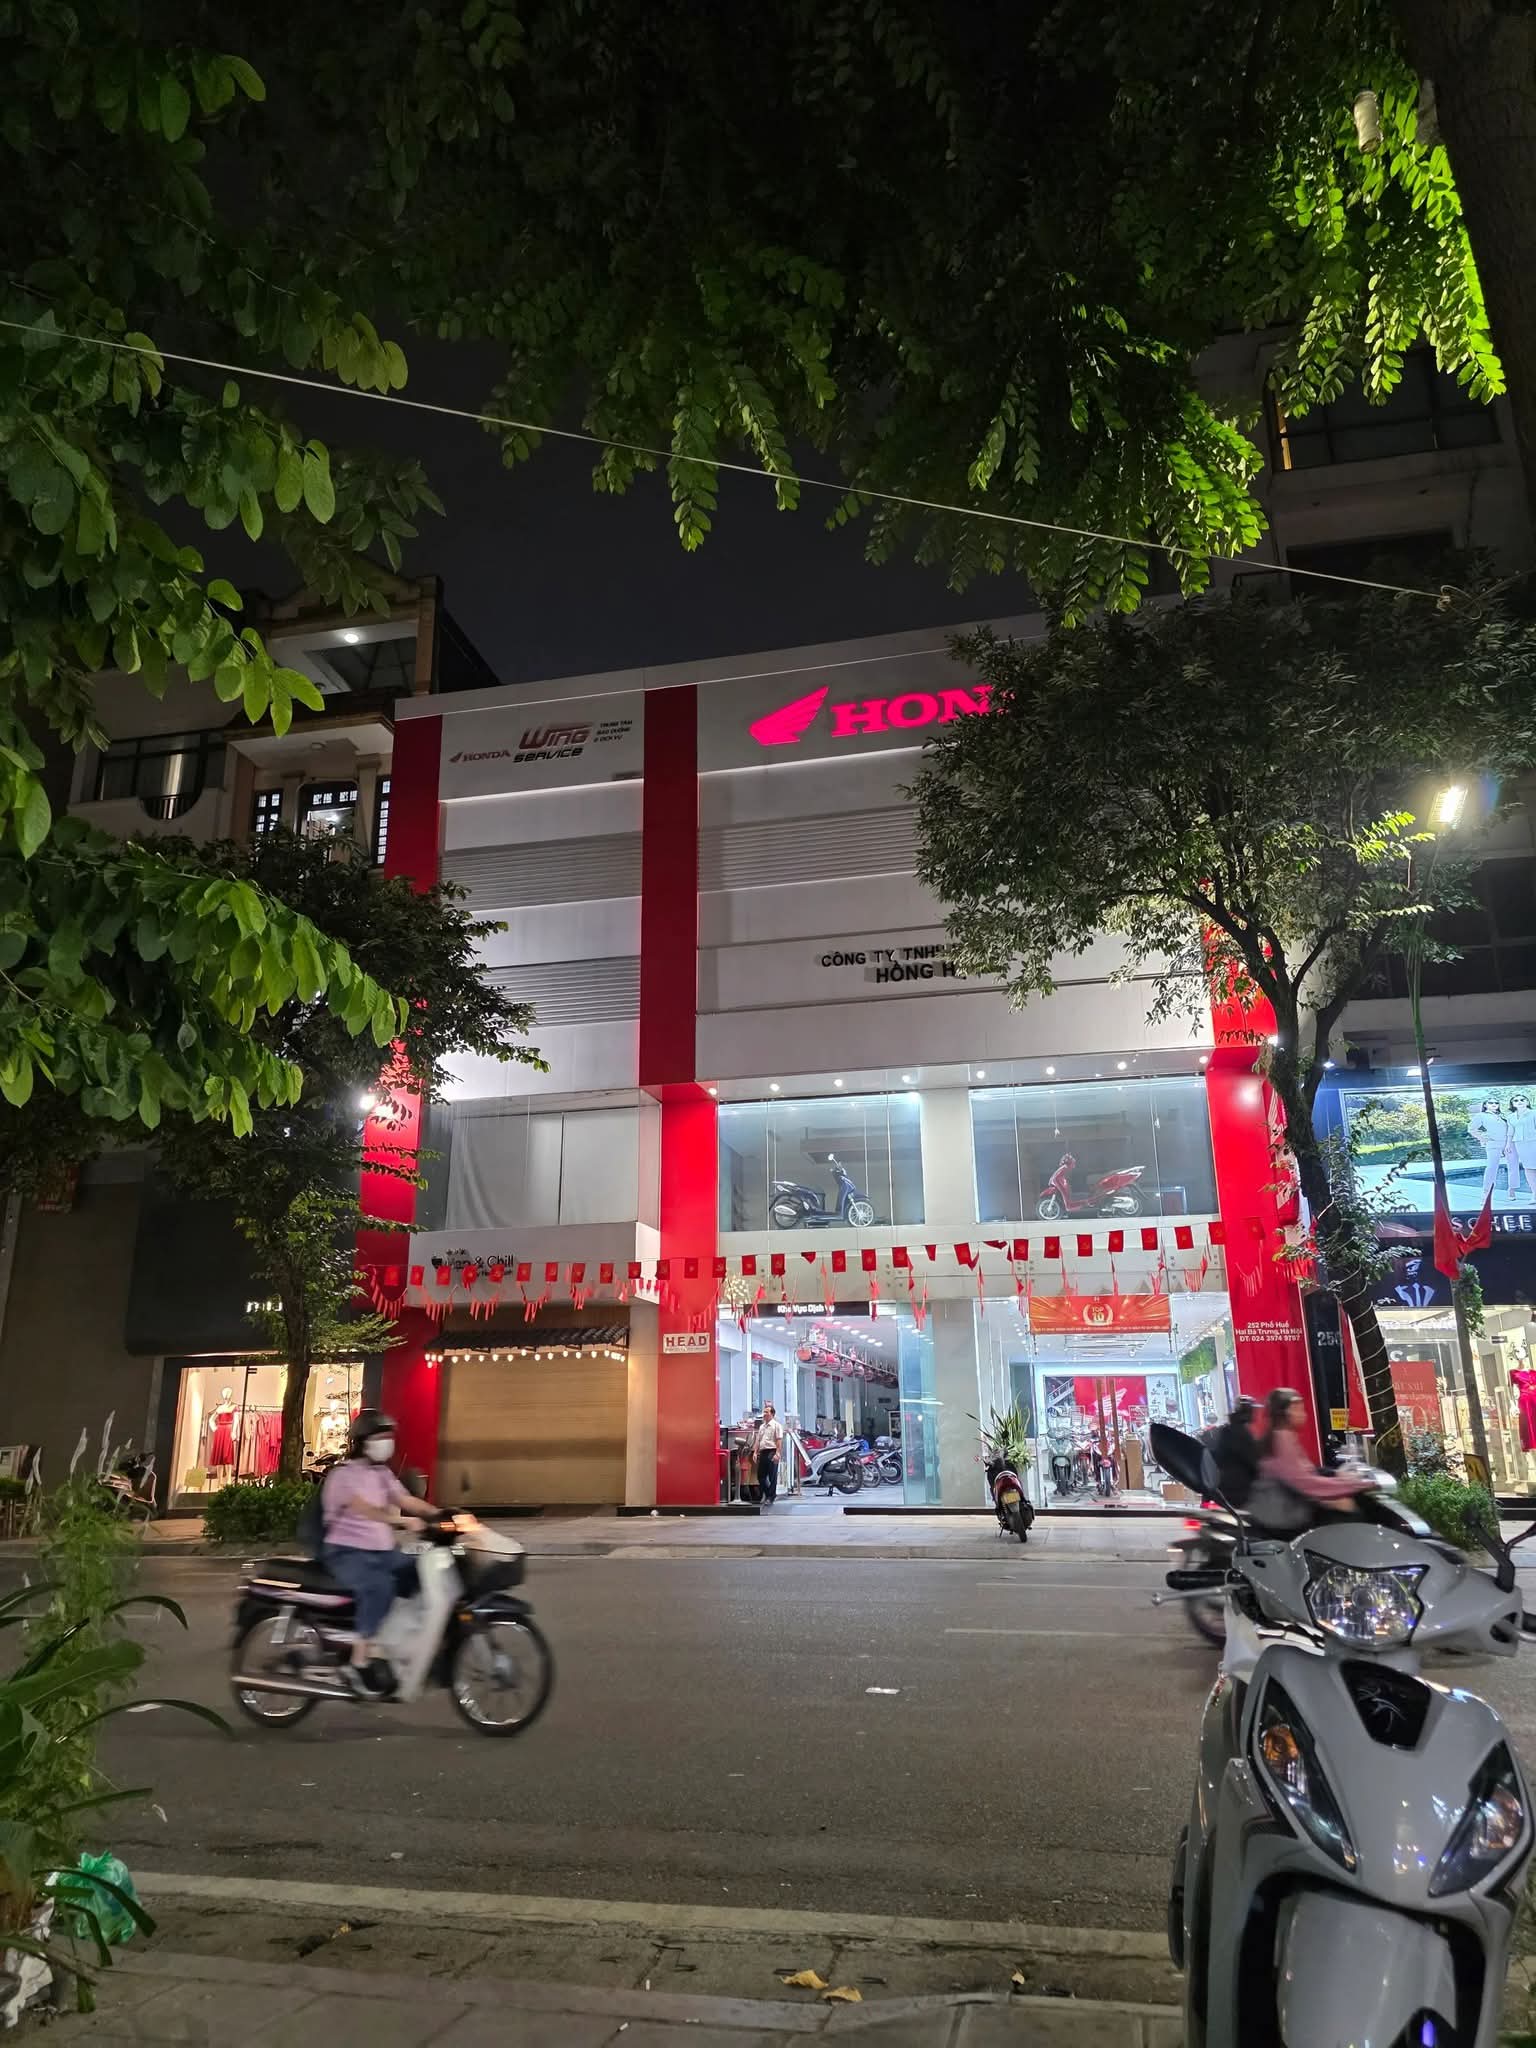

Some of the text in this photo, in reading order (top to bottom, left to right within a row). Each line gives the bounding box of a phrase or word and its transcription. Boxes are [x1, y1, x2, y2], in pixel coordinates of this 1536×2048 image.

[831, 684, 994, 737] HON
[463, 749, 512, 762] HONDA
[513, 747, 583, 763] SERVICE
[821, 952, 866, 967] CÔNG
[876, 960, 934, 983] HỒNG
[1092, 1312, 1104, 1322] 10
[666, 1336, 707, 1347] HEAD
